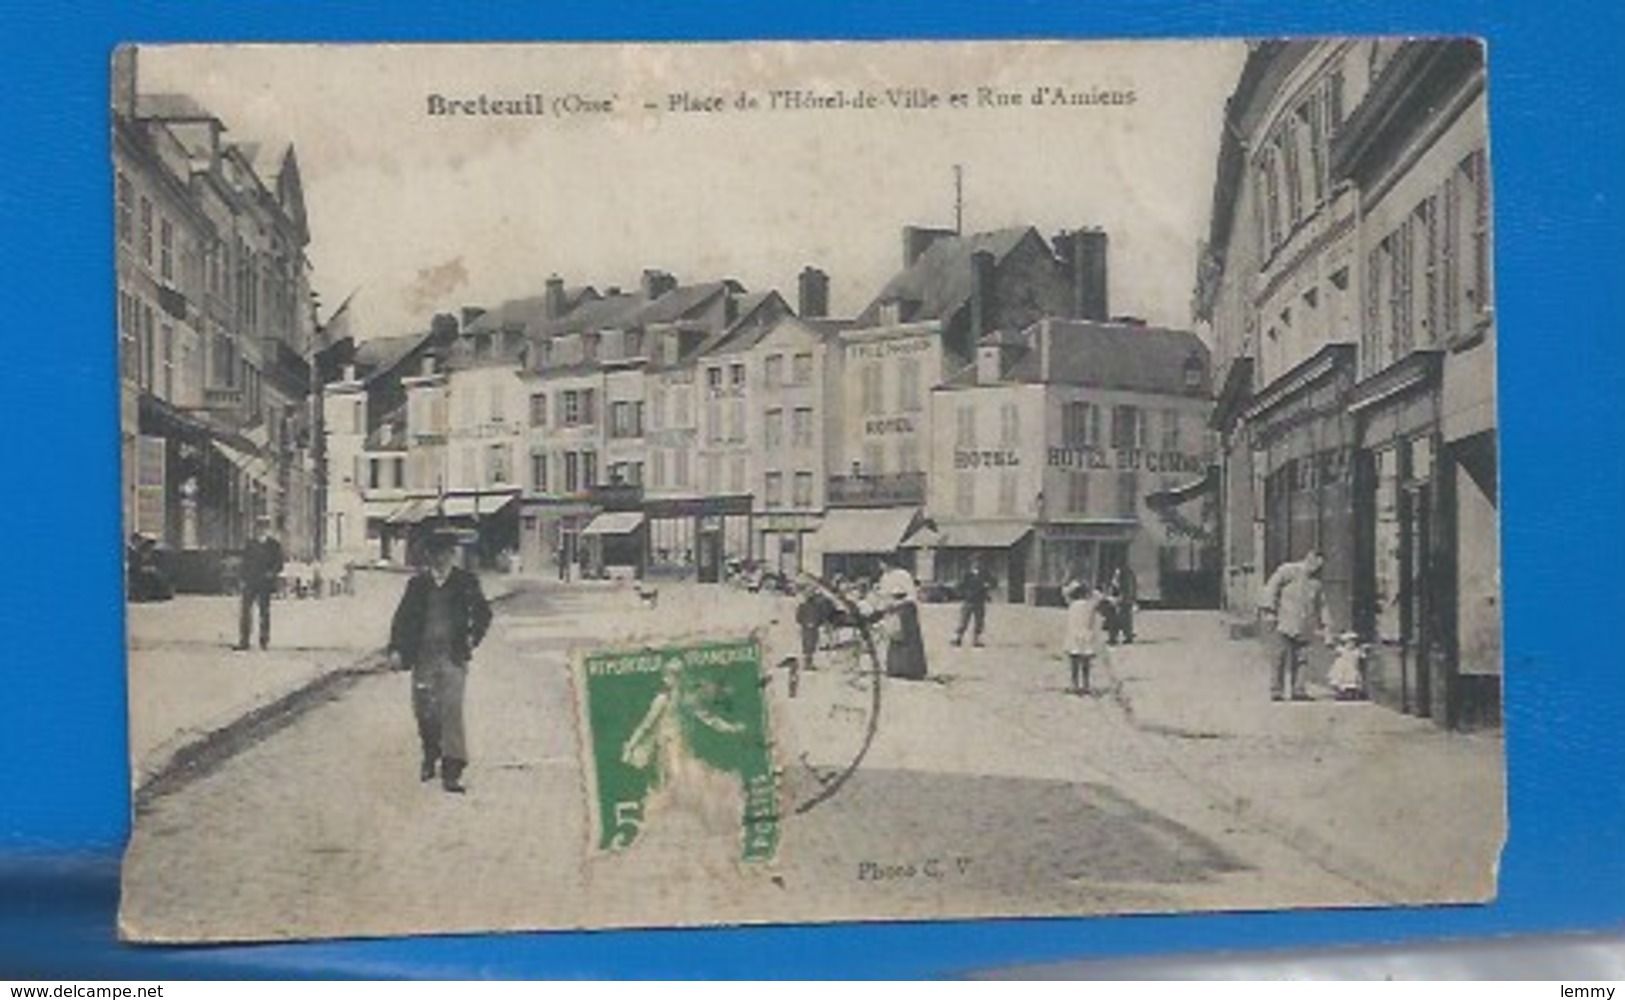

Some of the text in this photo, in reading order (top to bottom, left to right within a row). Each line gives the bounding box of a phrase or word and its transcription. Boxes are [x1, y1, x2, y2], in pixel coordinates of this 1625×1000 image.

[426, 94, 544, 116] Breteuil
[668, 92, 724, 112] Place
[734, 91, 757, 110] de
[950, 92, 968, 108] et
[976, 87, 1022, 109] Rue
[1031, 86, 1138, 106] d'Amiens
[953, 448, 1020, 469] HOTEL
